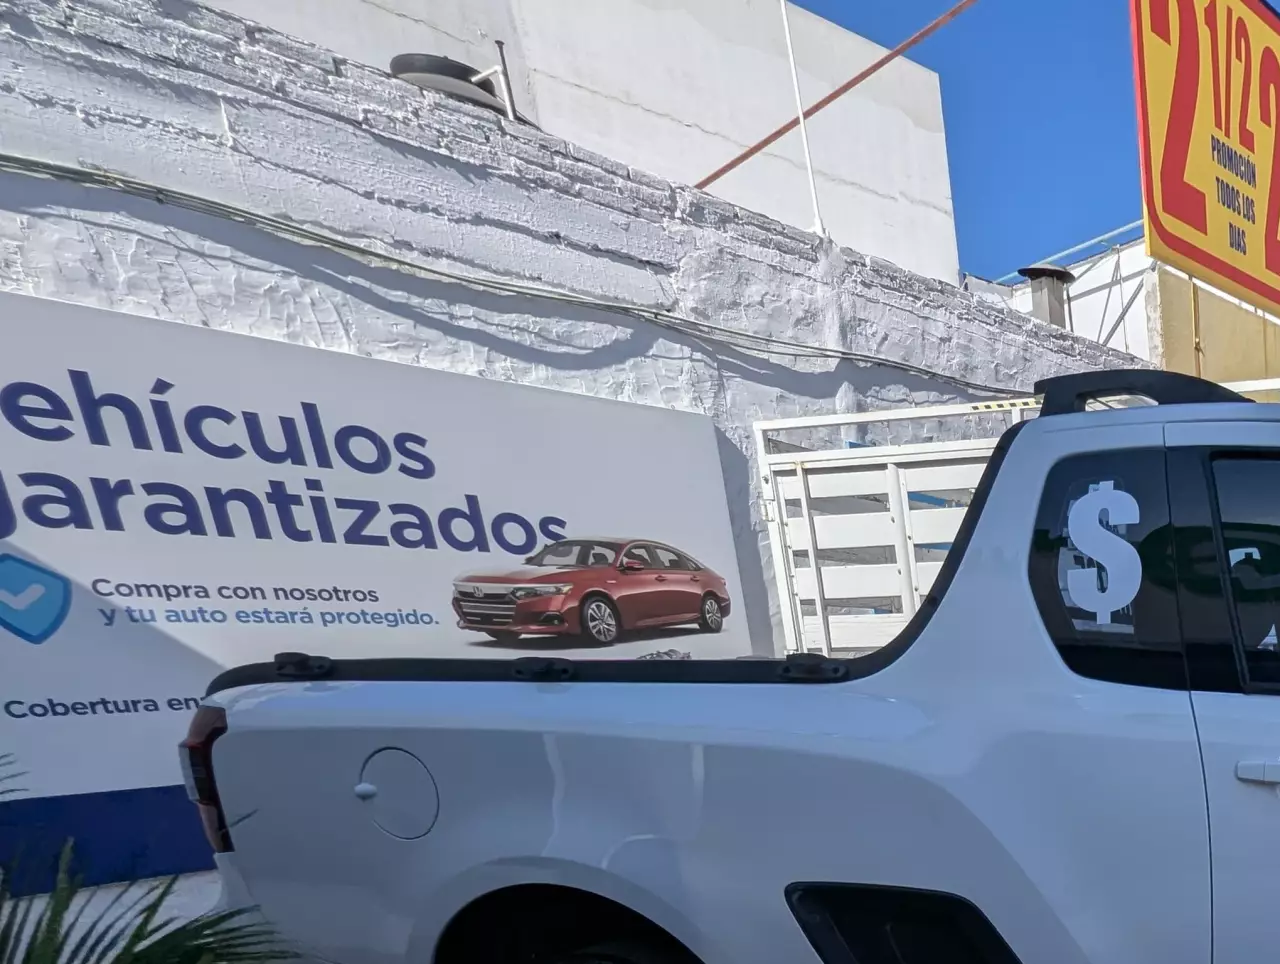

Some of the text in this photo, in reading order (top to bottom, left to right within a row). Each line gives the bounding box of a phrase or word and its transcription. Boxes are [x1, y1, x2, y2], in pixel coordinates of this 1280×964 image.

[1210, 133, 1256, 190] PROMOCIÓN
[1215, 175, 1256, 225] TODOS LOS
[1228, 221, 1247, 256] DIAS
[0, 368, 436, 480] ehículos
[91, 577, 380, 603] Compra con nosotros
[98, 605, 440, 628] y tu auto estará protegido.
[4, 697, 160, 719] Cobertura
